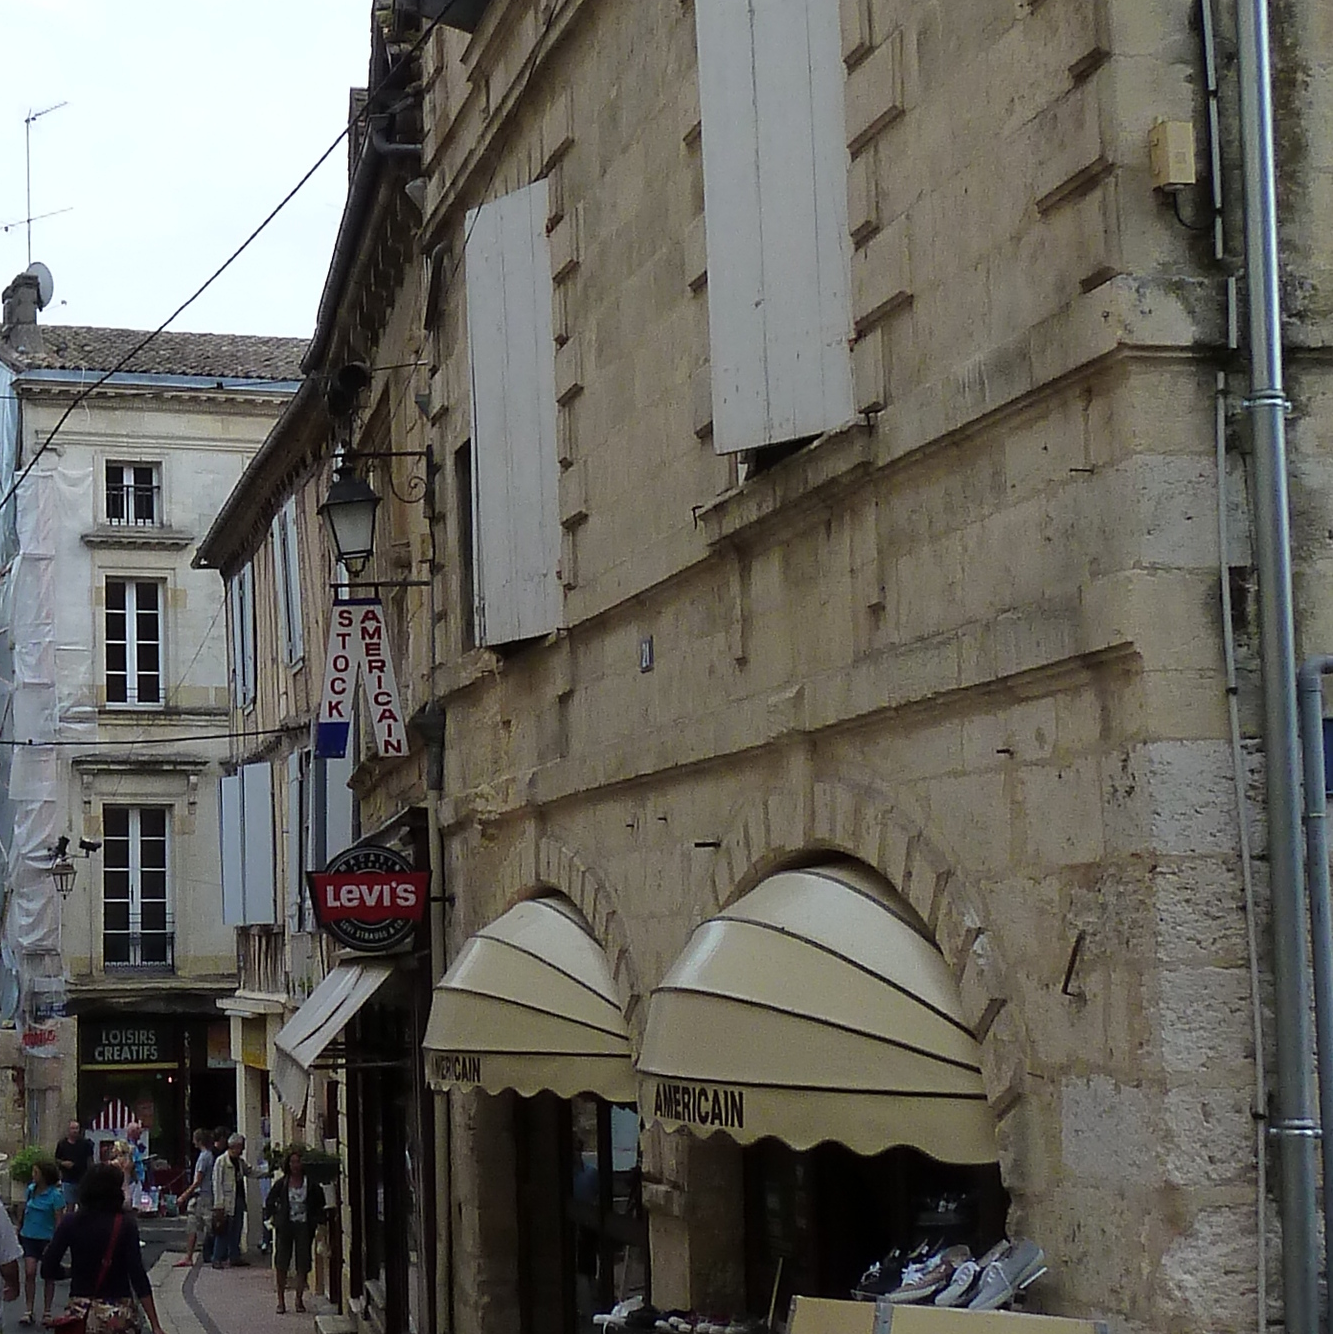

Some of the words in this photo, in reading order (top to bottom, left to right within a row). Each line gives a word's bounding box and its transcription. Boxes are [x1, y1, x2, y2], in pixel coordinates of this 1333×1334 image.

[327, 609, 354, 718] STOCK
[359, 609, 402, 754] AMERICAIN
[94, 1045, 158, 1061] CREATIFS
[101, 1029, 156, 1045] LOISIRS
[653, 1083, 744, 1128] AMERICAIN
